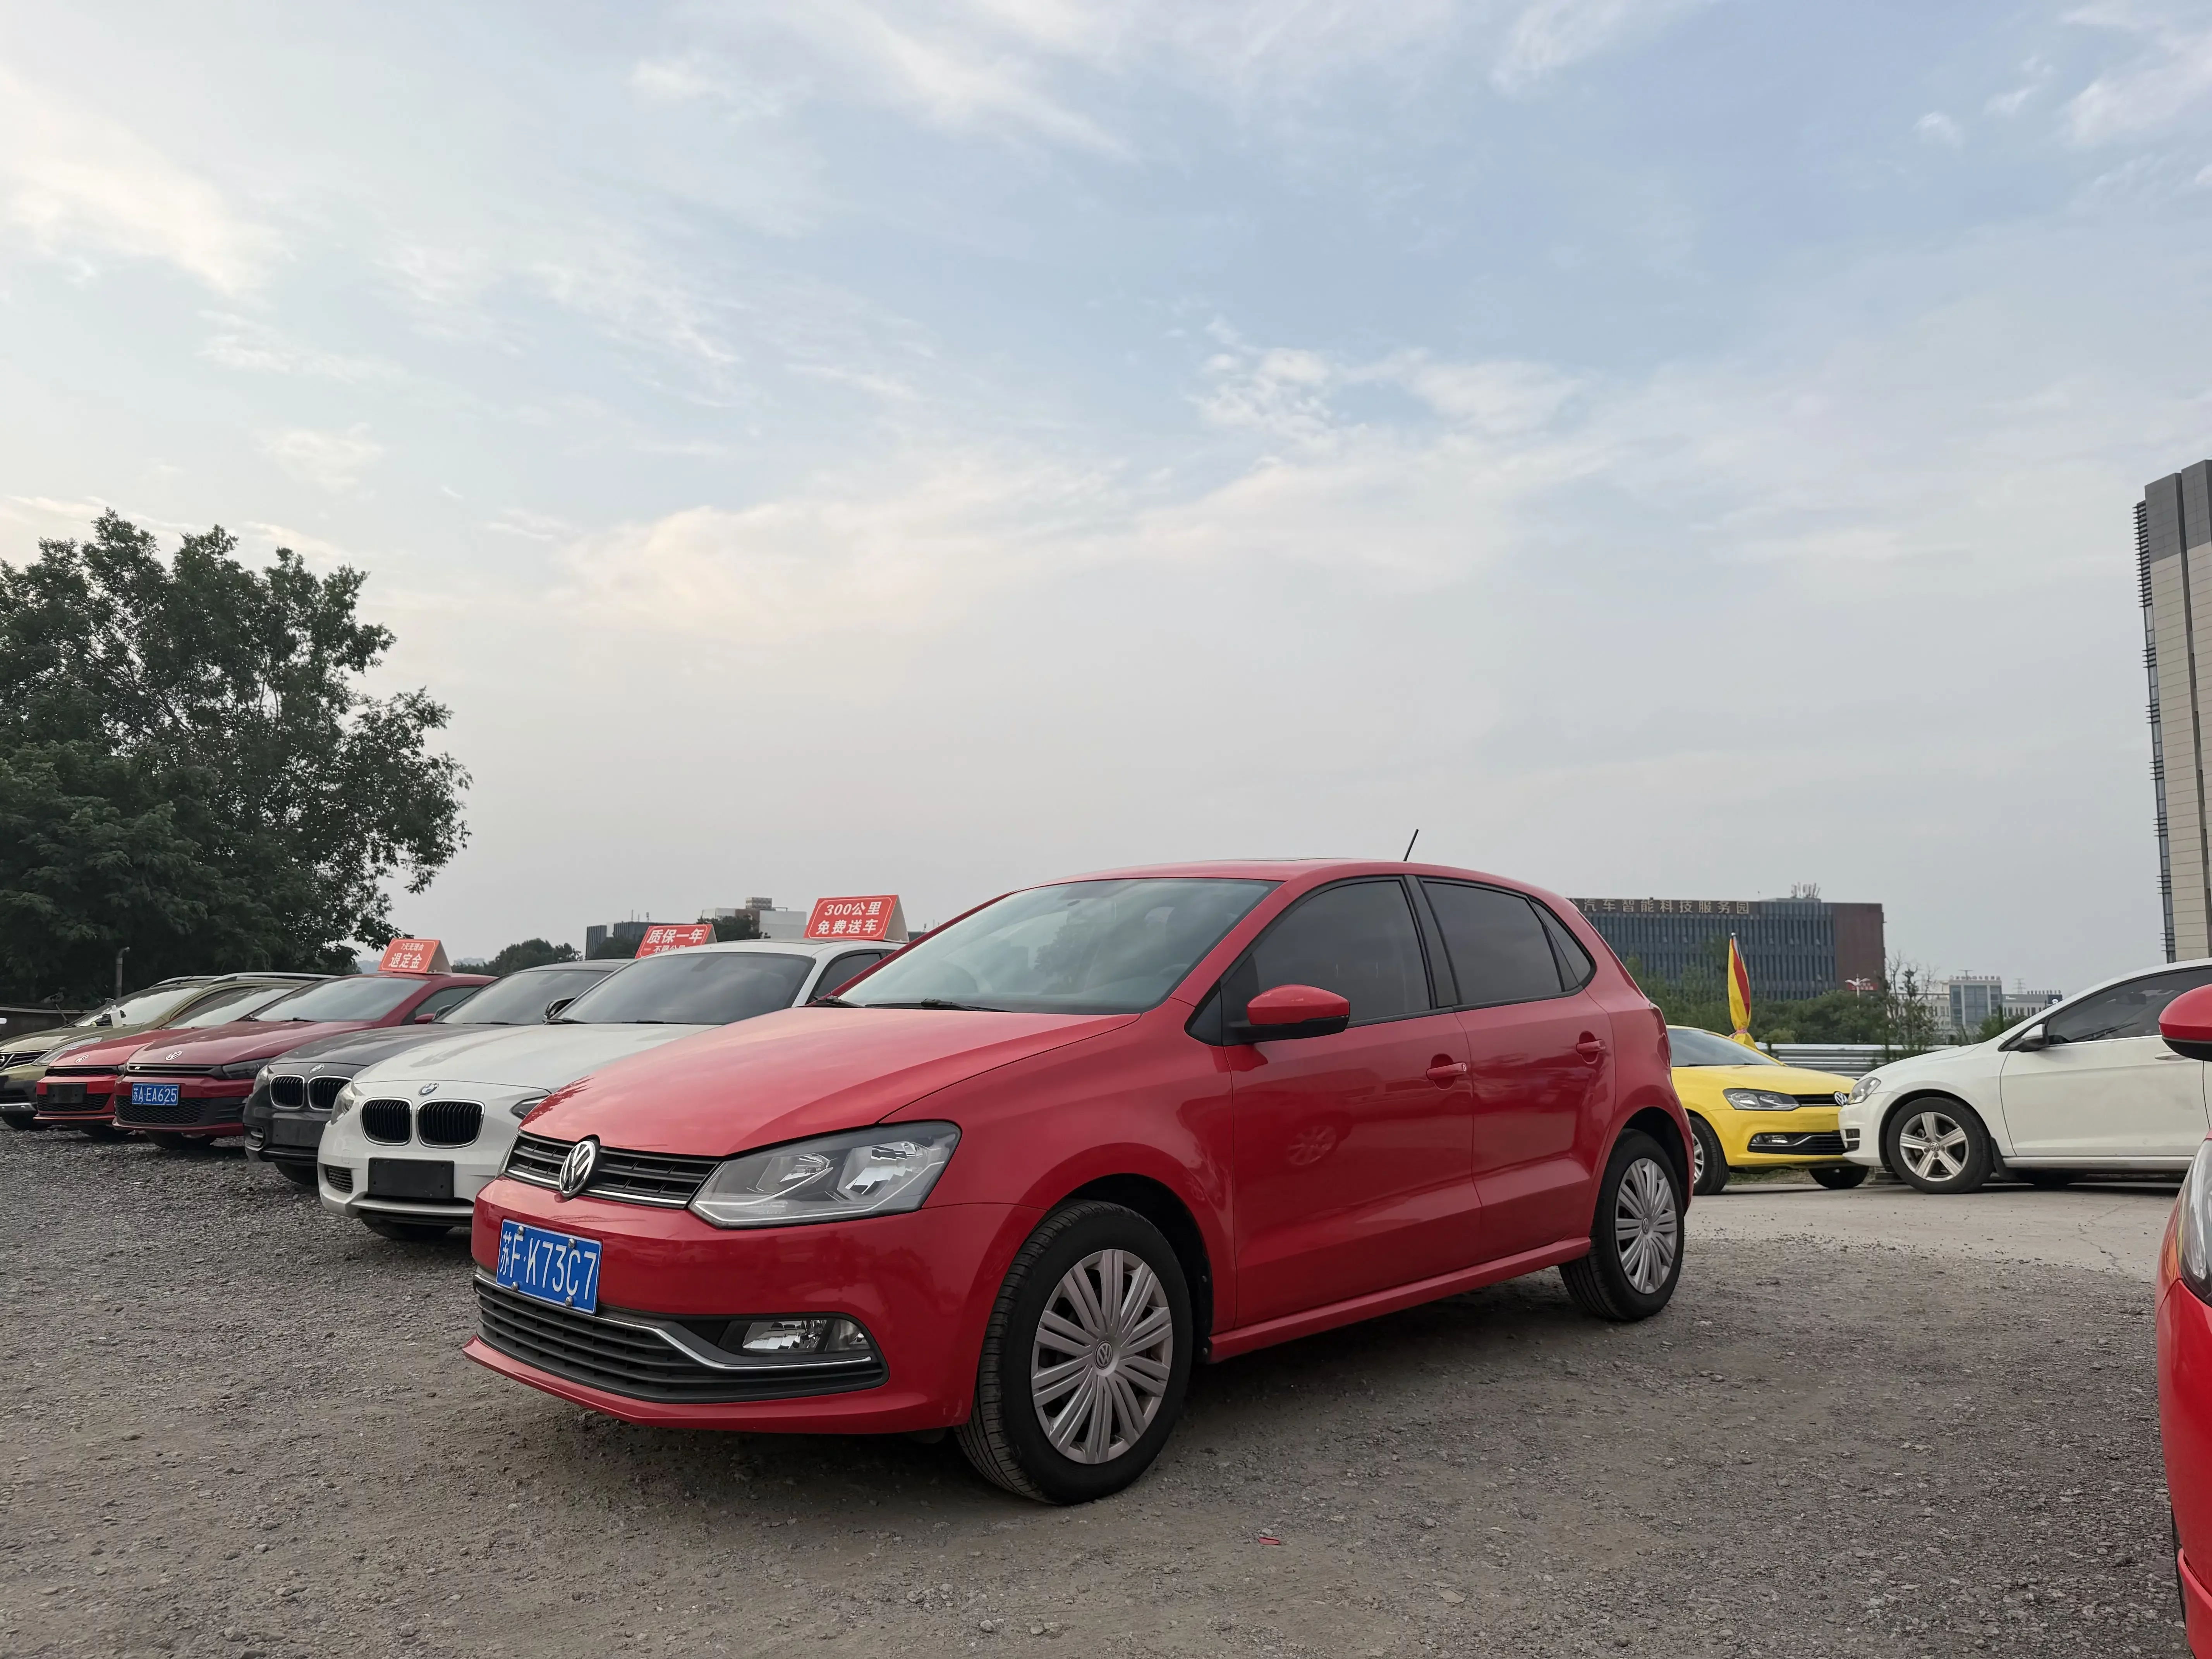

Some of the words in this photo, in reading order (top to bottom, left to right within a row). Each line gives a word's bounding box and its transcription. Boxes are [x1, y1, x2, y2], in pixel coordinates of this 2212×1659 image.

[824, 901, 881, 915] 300公里
[816, 919, 878, 934] 免费送车
[646, 928, 704, 944] 质保一年
[388, 953, 422, 969] 退定金
